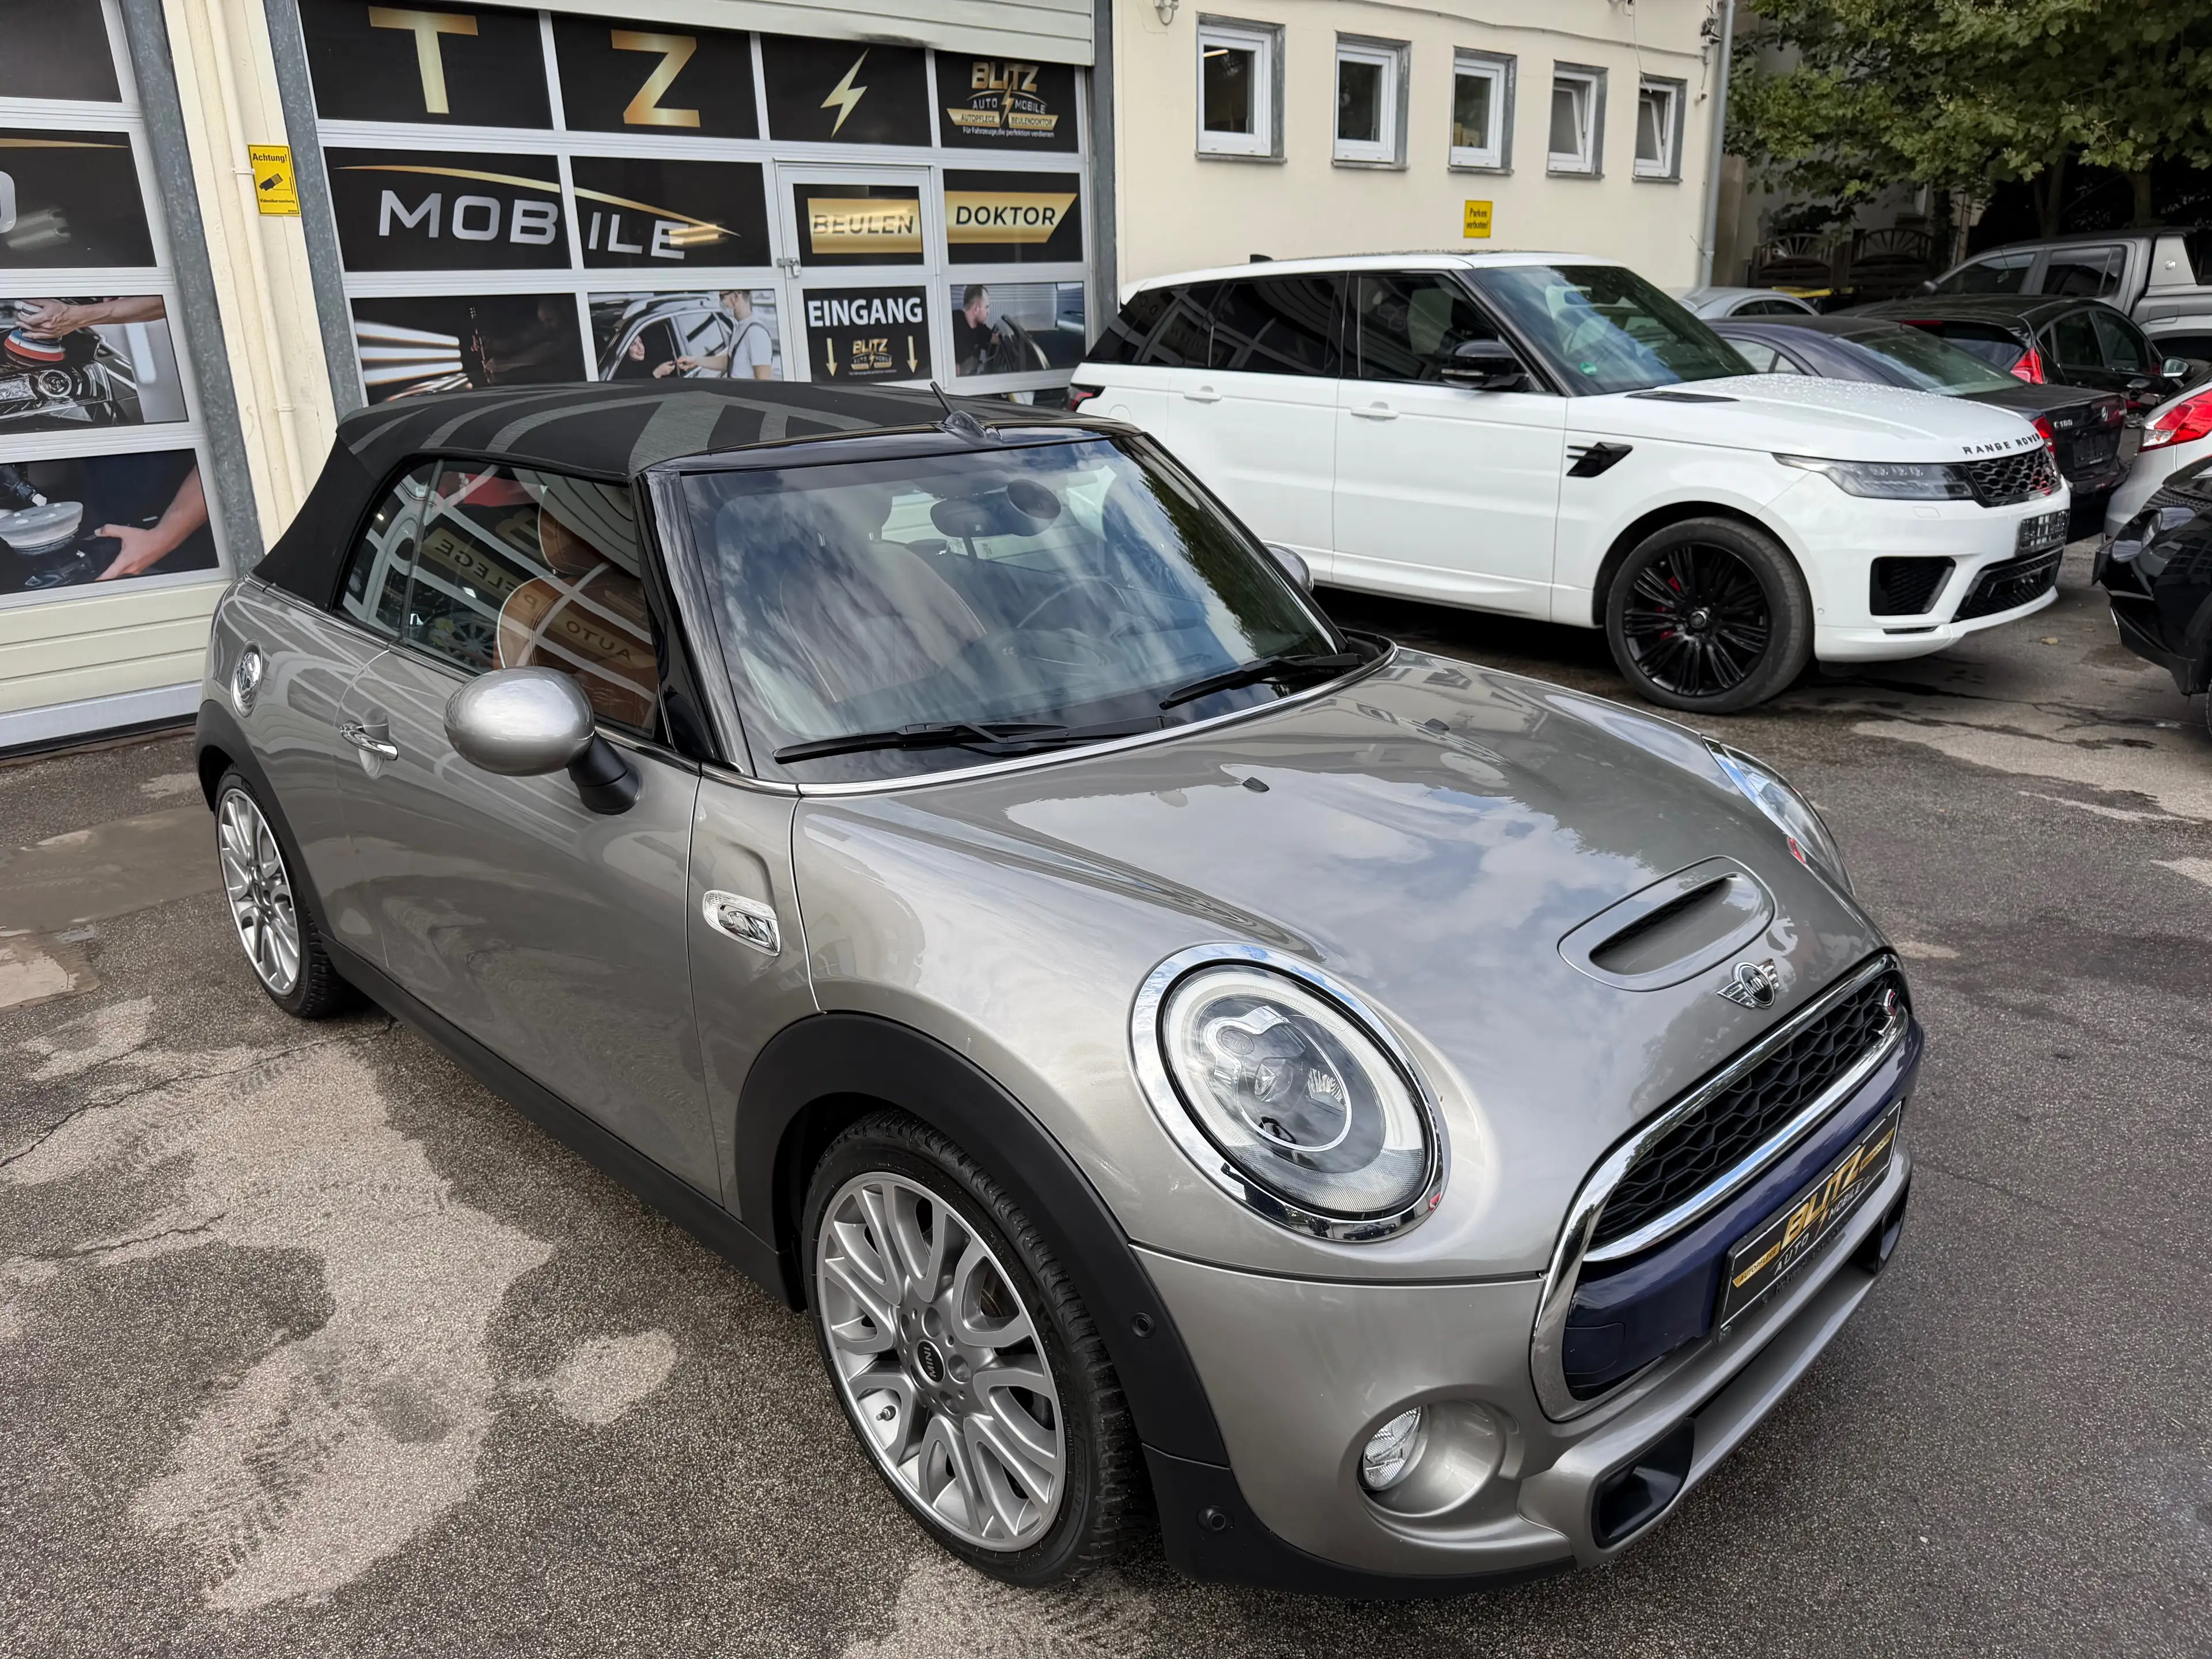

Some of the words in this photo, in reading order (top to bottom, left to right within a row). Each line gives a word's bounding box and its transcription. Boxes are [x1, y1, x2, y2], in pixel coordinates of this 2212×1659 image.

[368, 6, 478, 114] T
[611, 29, 700, 127] Z
[971, 61, 1039, 93] BLITZ
[961, 113, 996, 124] AUTOPFLEGE
[972, 97, 998, 111] AUTO
[1014, 99, 1046, 115] MOBILE
[253, 153, 287, 164] Achtung!
[378, 190, 689, 259] MOBILE
[813, 214, 914, 234] BEULEN
[955, 206, 1056, 226] DOKTOR
[808, 297, 923, 328] EINGANG
[853, 338, 888, 354] BLITZ
[1962, 441, 2012, 455] RANGE
[1781, 1145, 1866, 1250] BLITZ
[1774, 1233, 1809, 1277] AUTO
[1828, 1181, 1862, 1221] MOBILE
[923, 1346, 937, 1378] MINI
